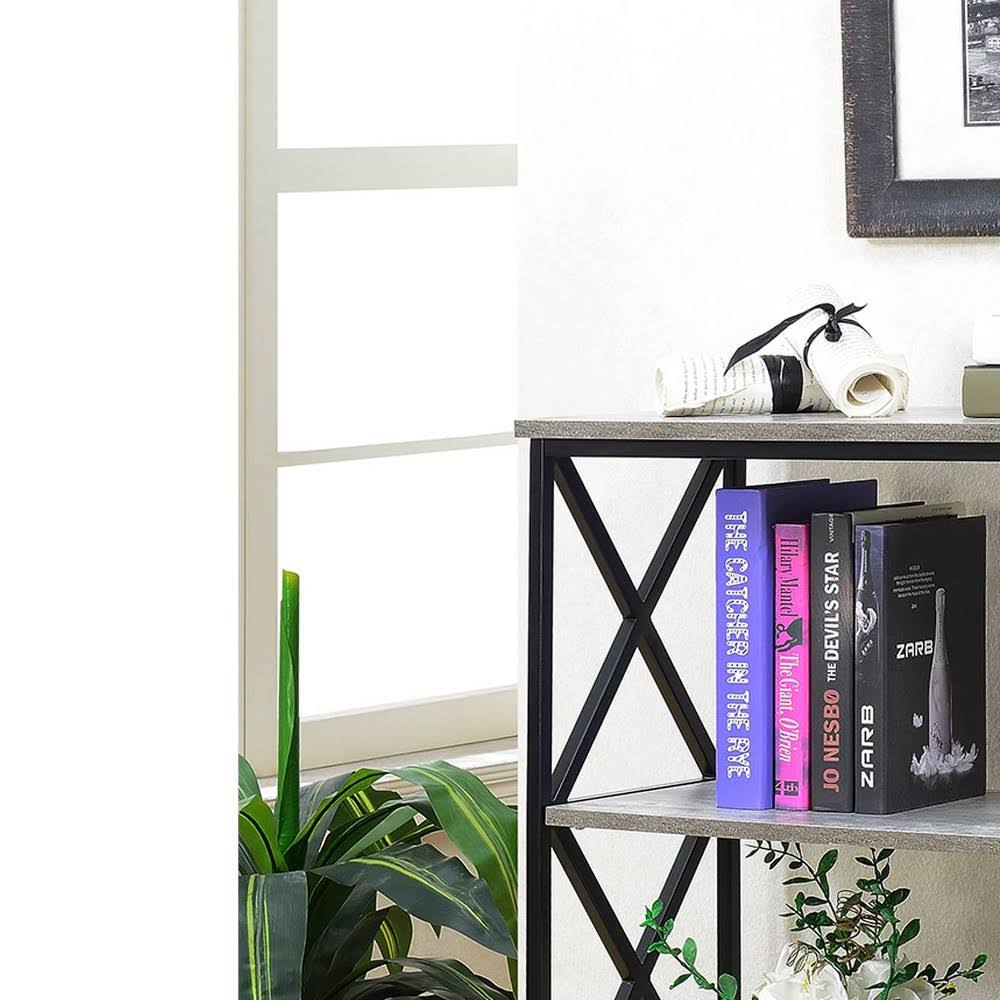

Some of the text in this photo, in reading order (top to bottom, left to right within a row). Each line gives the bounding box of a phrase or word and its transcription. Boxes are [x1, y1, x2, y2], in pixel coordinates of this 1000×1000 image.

[780, 538, 800, 617] Hilary Mantel
[824, 551, 840, 683] THE DEVIL'S STAR
[724, 511, 751, 780] THE CATCHER IN THE RYE
[779, 653, 800, 677] The
[896, 639, 934, 660] ZARB
[779, 717, 800, 763] O'Brien
[823, 689, 841, 793] JO NESBØ
[861, 705, 874, 788] ZARB
